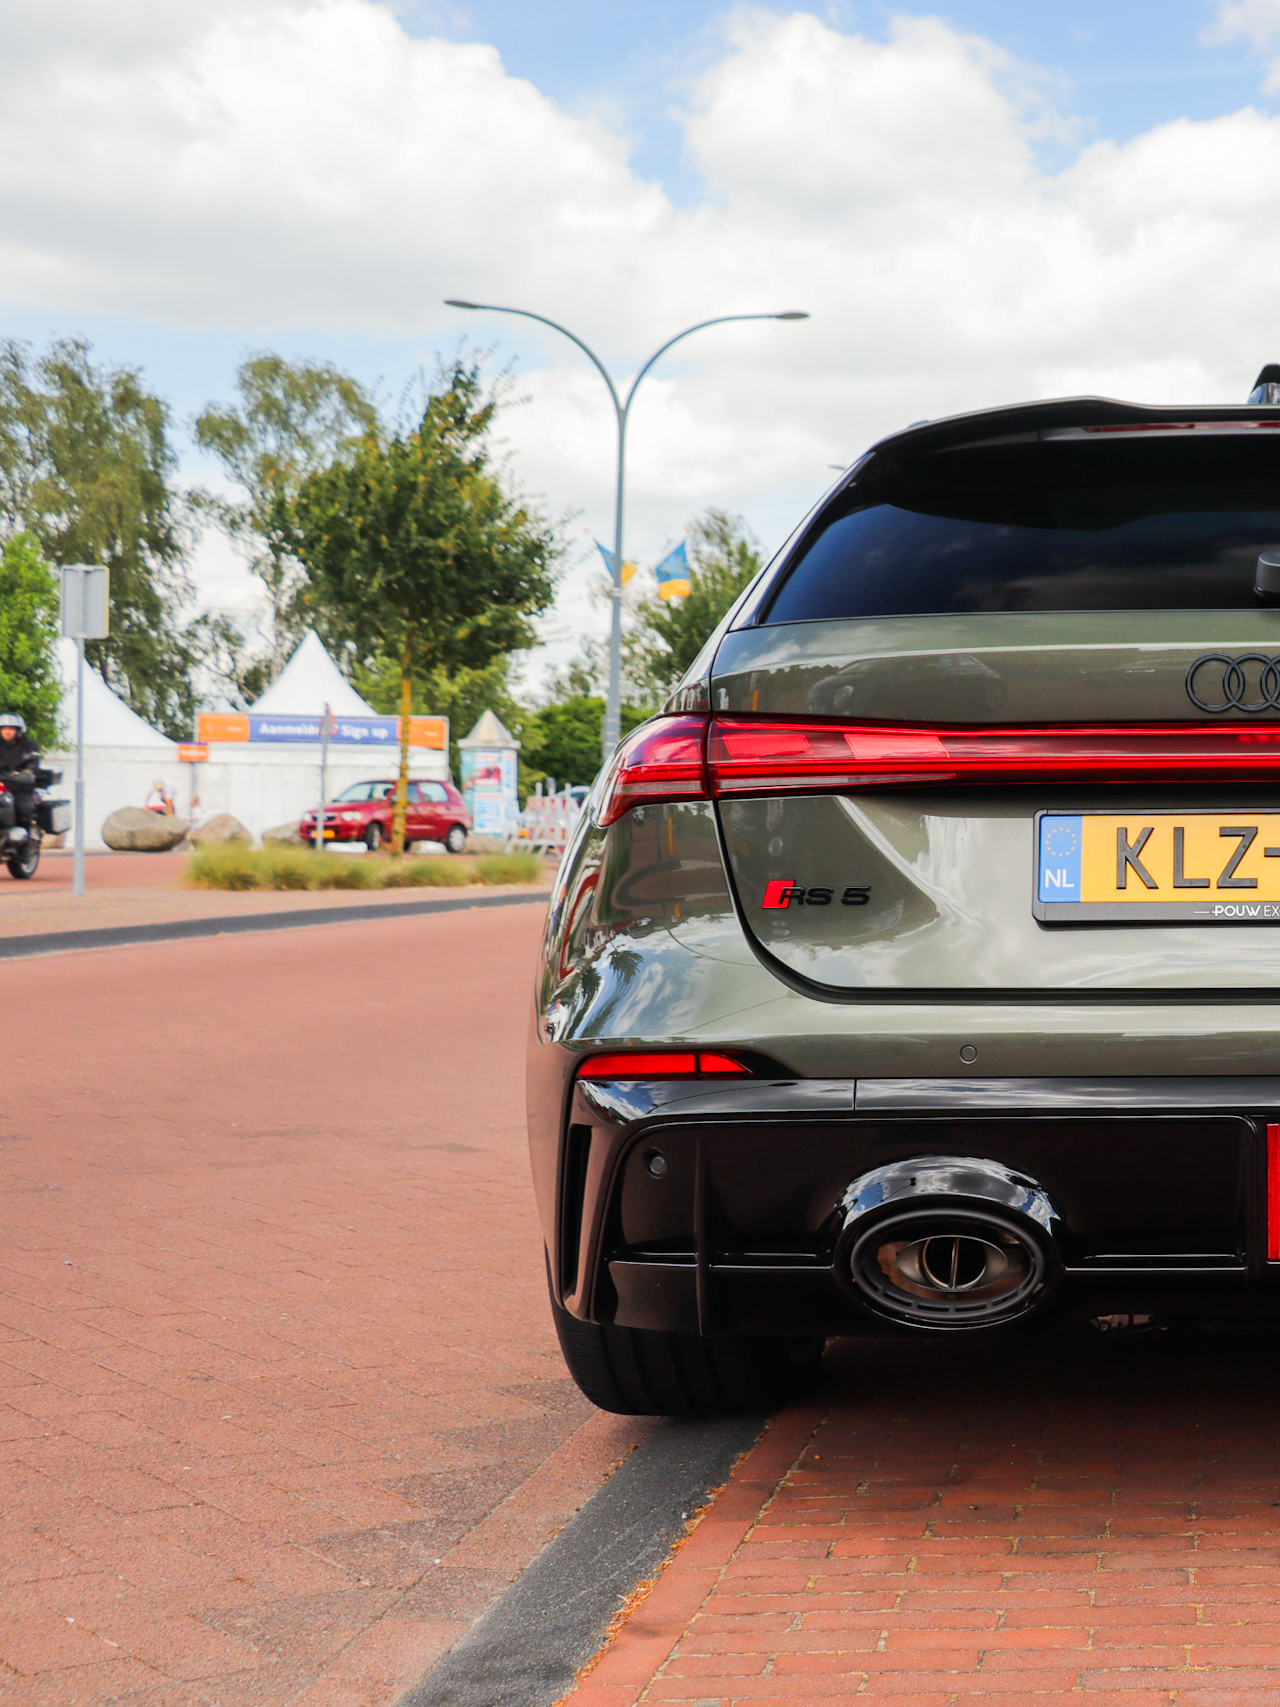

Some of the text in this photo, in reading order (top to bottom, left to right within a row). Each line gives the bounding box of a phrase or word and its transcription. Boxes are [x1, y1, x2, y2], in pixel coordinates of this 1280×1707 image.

[341, 724, 370, 740] Sign
[371, 728, 389, 740] up
[1044, 869, 1075, 888] NL
[776, 885, 871, 906] RS 5
[1213, 905, 1261, 918] POUW
